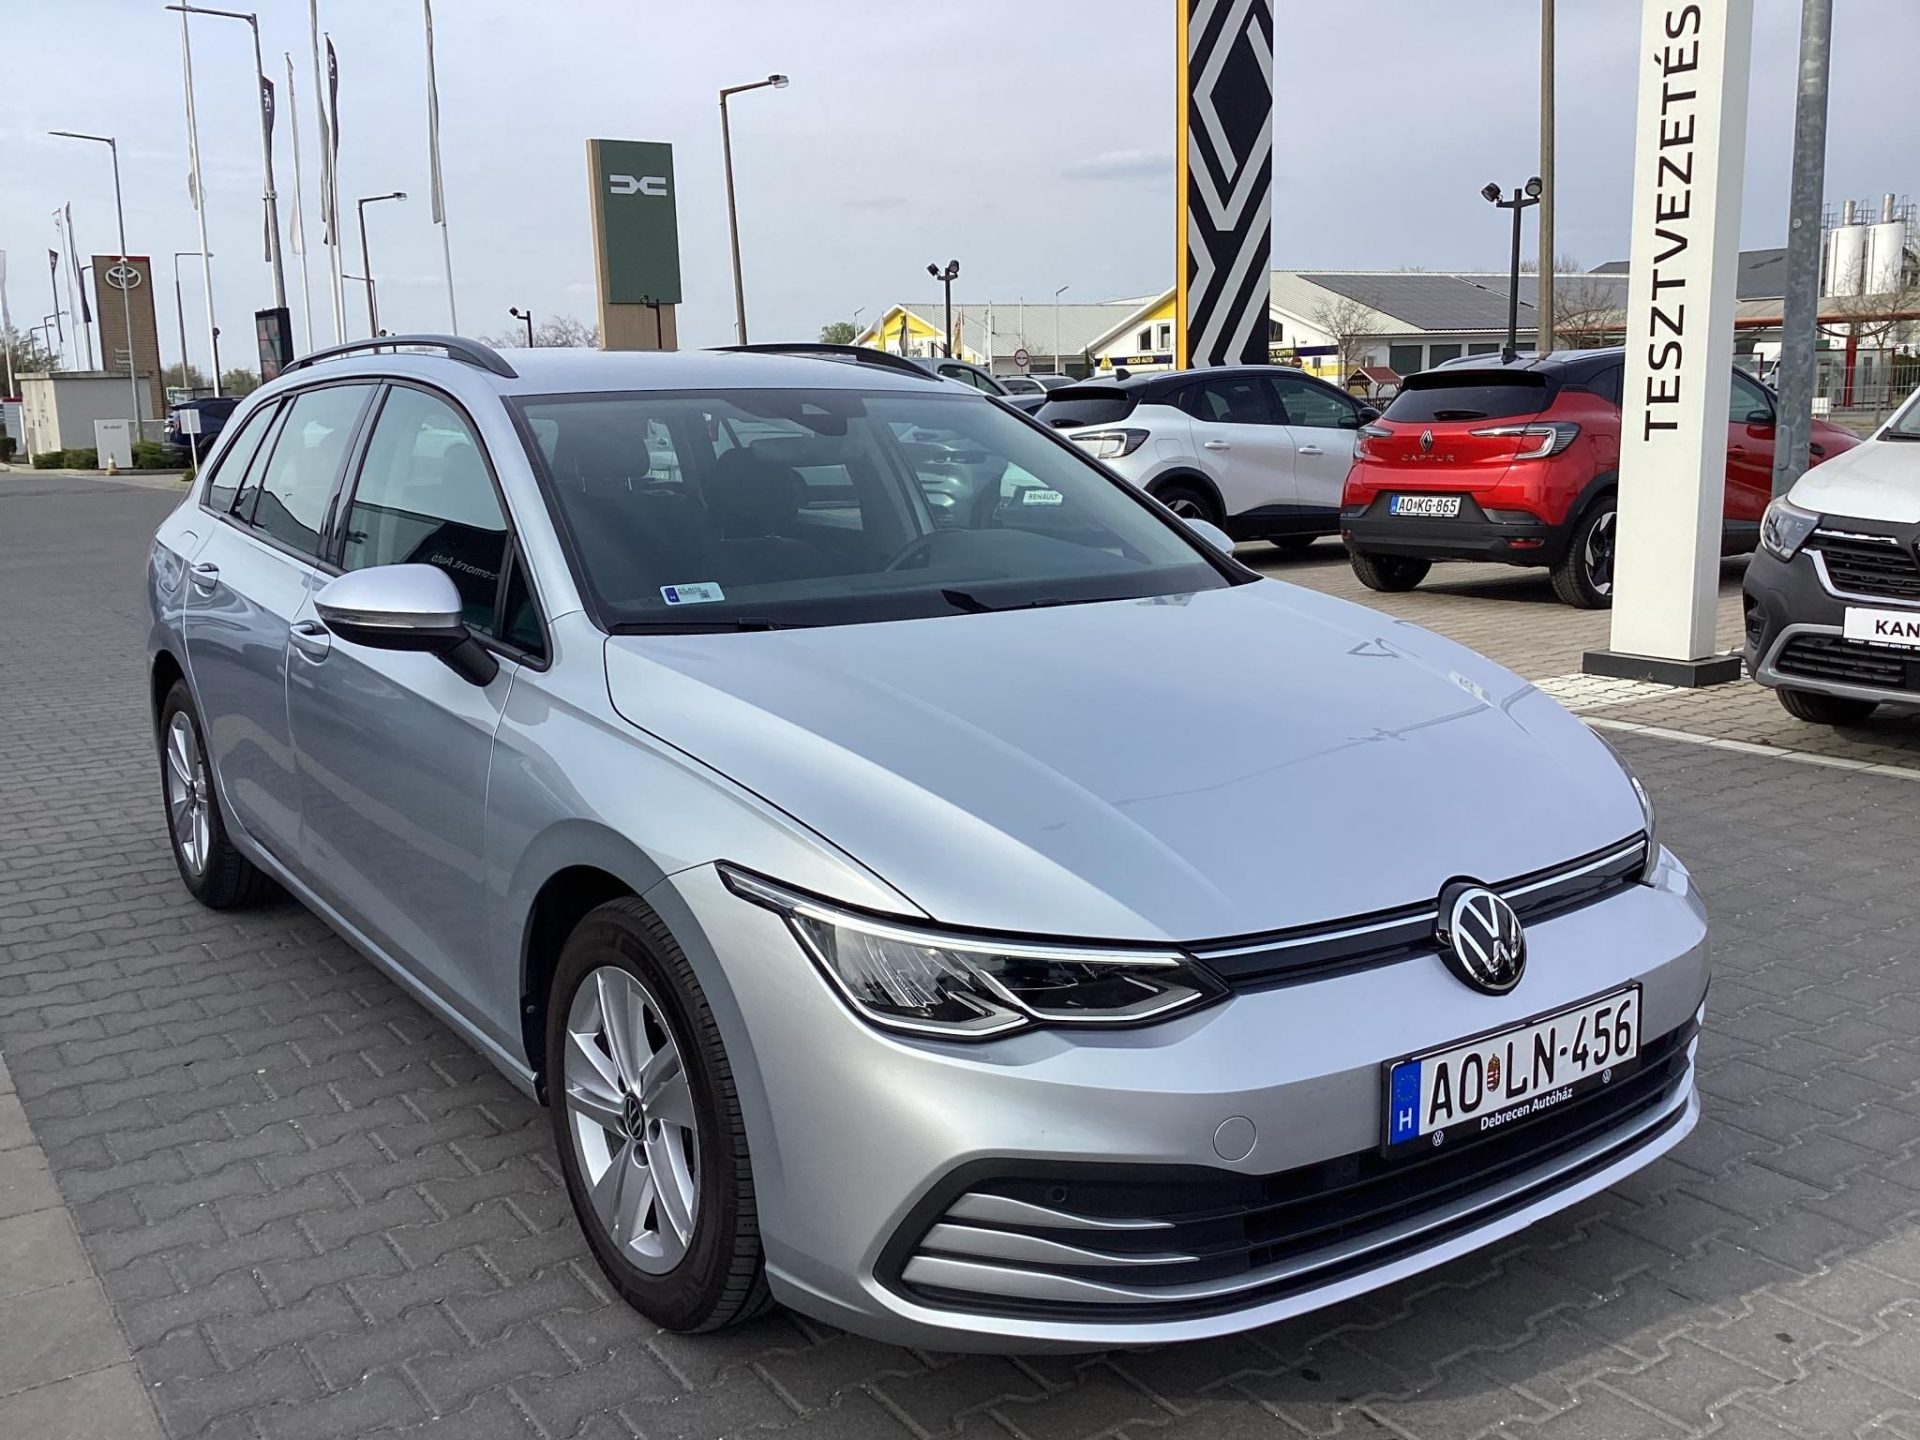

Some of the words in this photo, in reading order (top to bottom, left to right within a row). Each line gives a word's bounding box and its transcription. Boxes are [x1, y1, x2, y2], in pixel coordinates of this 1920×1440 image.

[1643, 3, 1702, 442] TESZTVEZETÉS
[1401, 454, 1455, 462] CAPTUR
[1028, 493, 1059, 501] RENAULT
[1398, 498, 1413, 512] AO
[1417, 499, 1457, 513] KG-865
[1875, 619, 1920, 638] KAN
[1427, 1052, 1484, 1125] AO
[1506, 1000, 1631, 1099] LN-456
[1480, 1104, 1531, 1131] Debrecen
[1531, 1086, 1573, 1113] Autóház
[1399, 1108, 1413, 1132] H
